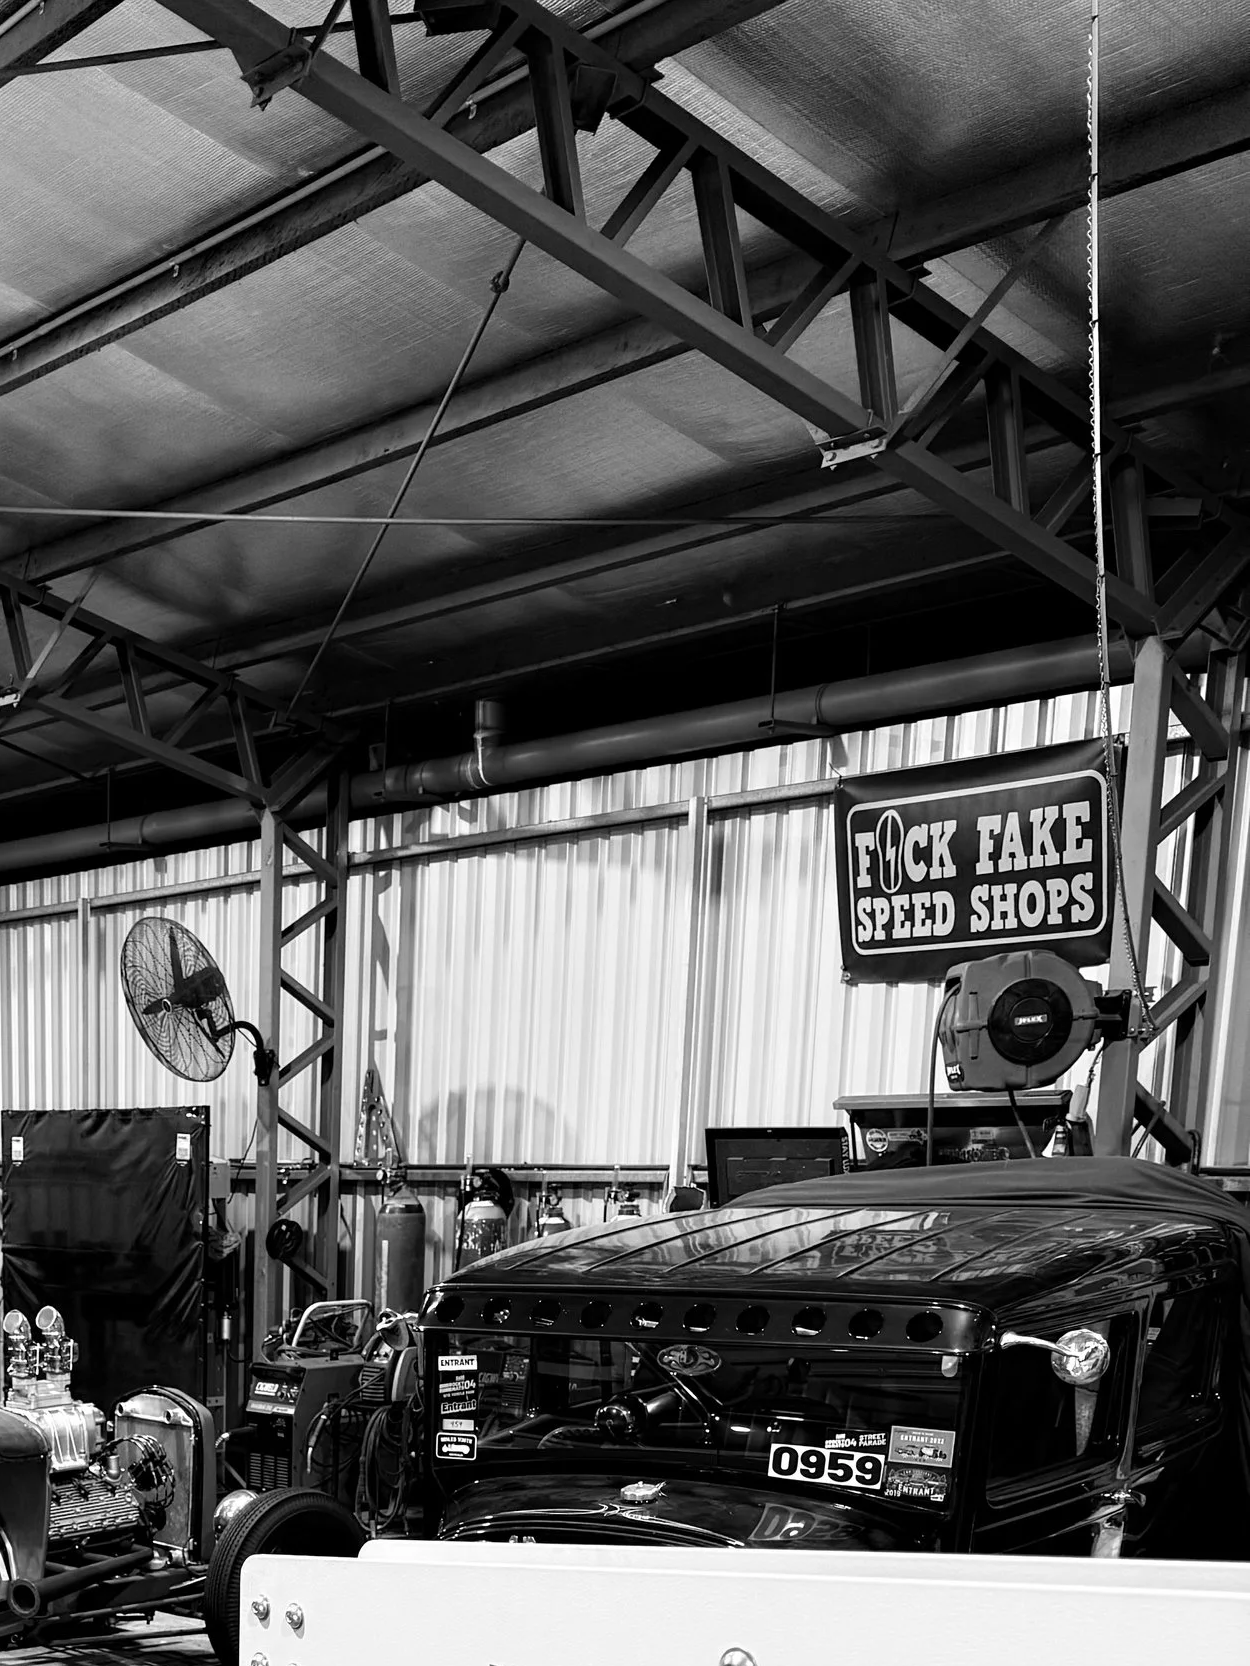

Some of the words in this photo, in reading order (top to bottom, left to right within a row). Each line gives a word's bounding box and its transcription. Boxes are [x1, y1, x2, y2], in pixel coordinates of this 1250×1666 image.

[975, 801, 1093, 875] FAKE
[856, 891, 956, 943] SPEED
[969, 872, 1095, 933] SHOPS
[440, 1358, 475, 1367] ENTRANT
[441, 1400, 477, 1413] Entrant
[858, 1439, 887, 1447] PARADE
[859, 1433, 886, 1441] STREET
[900, 1434, 928, 1443] ENTRANT
[771, 1445, 883, 1487] 0959
[884, 1488, 901, 1498] 2019
[898, 1483, 935, 1497] ENTRANT
